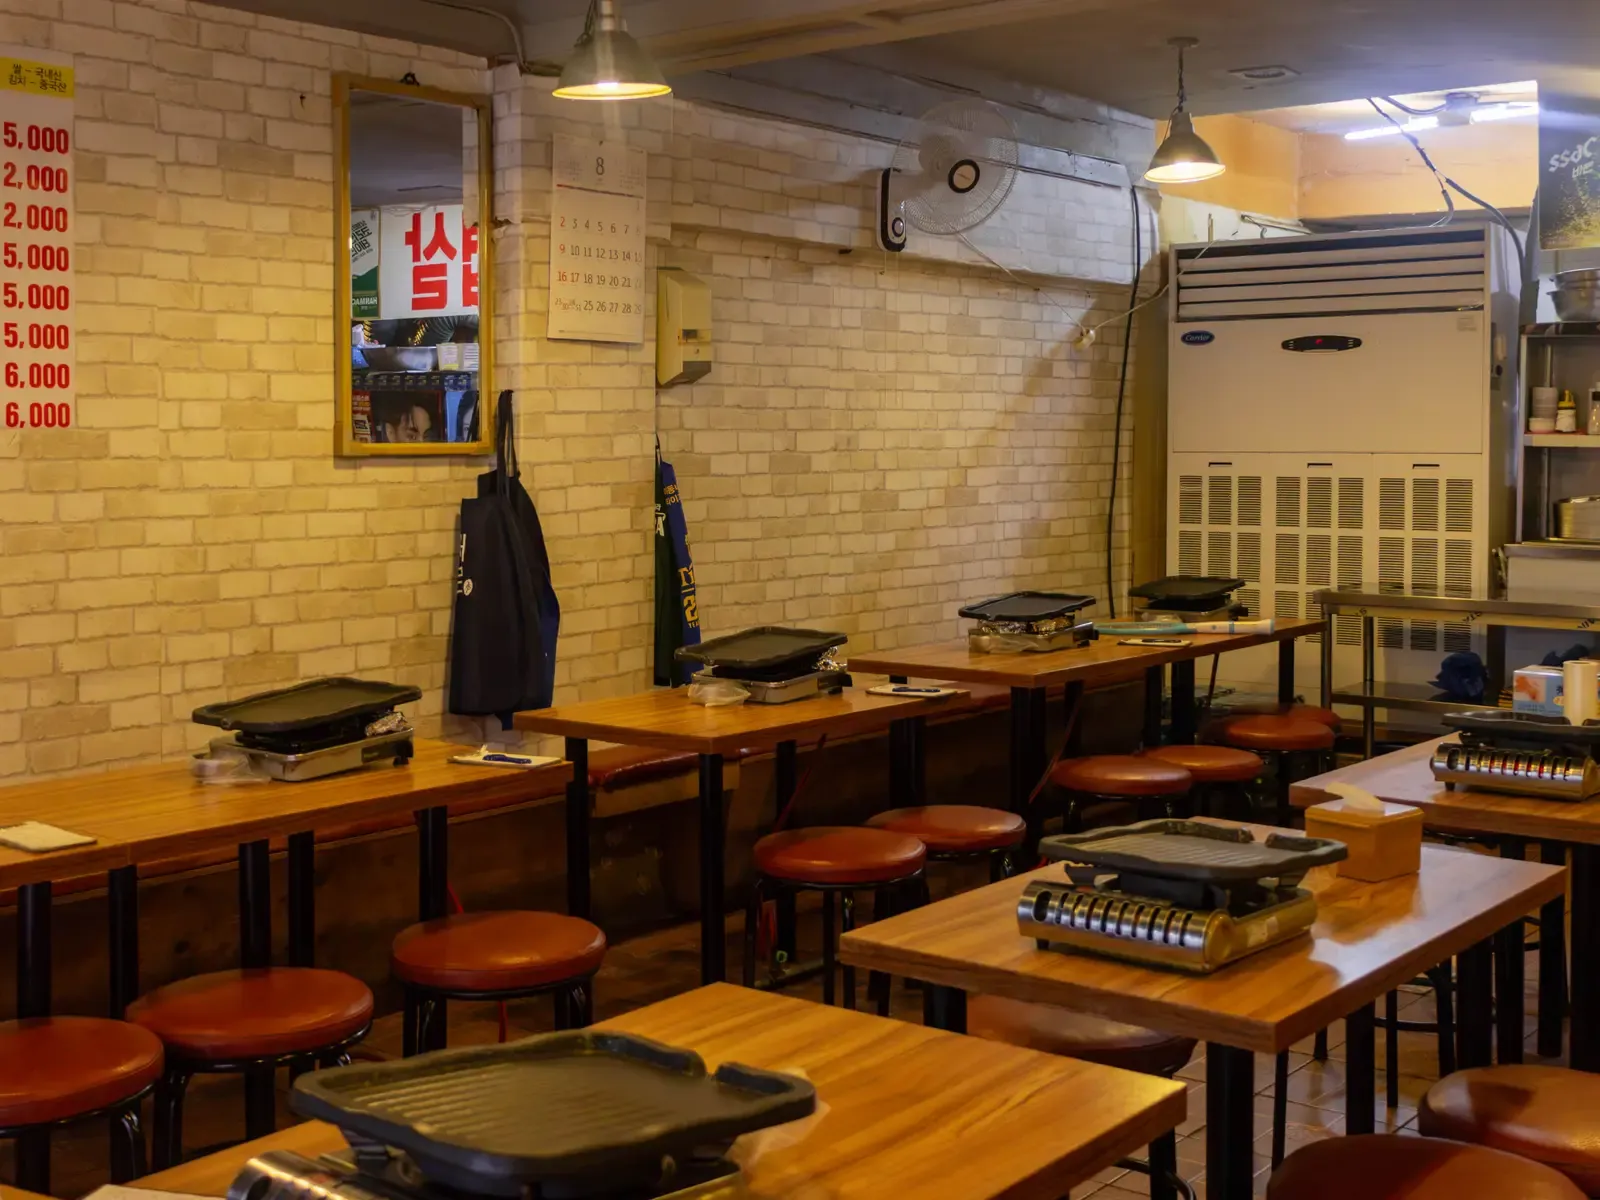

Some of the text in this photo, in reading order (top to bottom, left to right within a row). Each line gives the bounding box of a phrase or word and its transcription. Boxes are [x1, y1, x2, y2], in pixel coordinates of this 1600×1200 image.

[13, 63, 22, 75] 쌀
[35, 67, 62, 81] 국내산
[9, 74, 26, 87] 김치
[40, 78, 67, 93] 중국산
[3, 122, 69, 154] 5,000
[3, 162, 68, 193] 2,000
[596, 157, 605, 176] 8
[3, 202, 68, 232] 2,000
[560, 217, 565, 227] 2
[572, 219, 577, 229] 3
[584, 220, 590, 230] 4
[597, 221, 603, 232] 5
[610, 223, 616, 233] 6
[624, 224, 629, 235] 7
[3, 243, 69, 272] 5,000
[559, 244, 565, 254] 9
[570, 245, 580, 256] 10
[583, 246, 592, 257] 11
[596, 248, 606, 259] 12
[608, 249, 619, 260] 13
[622, 250, 631, 261] 14
[557, 271, 567, 282] 16
[570, 272, 580, 283] 17
[583, 273, 593, 284] 18
[596, 274, 606, 285] 19
[609, 276, 619, 286] 20
[621, 277, 631, 288] 21
[3, 283, 69, 310] 5,000
[583, 300, 593, 311] 25
[596, 301, 606, 312] 26
[609, 302, 619, 313] 27
[621, 303, 631, 314] 28
[4, 323, 69, 350] 5,000
[1185, 333, 1210, 341] Carrier
[5, 362, 70, 389] 6,000
[5, 402, 71, 428] 6,000
